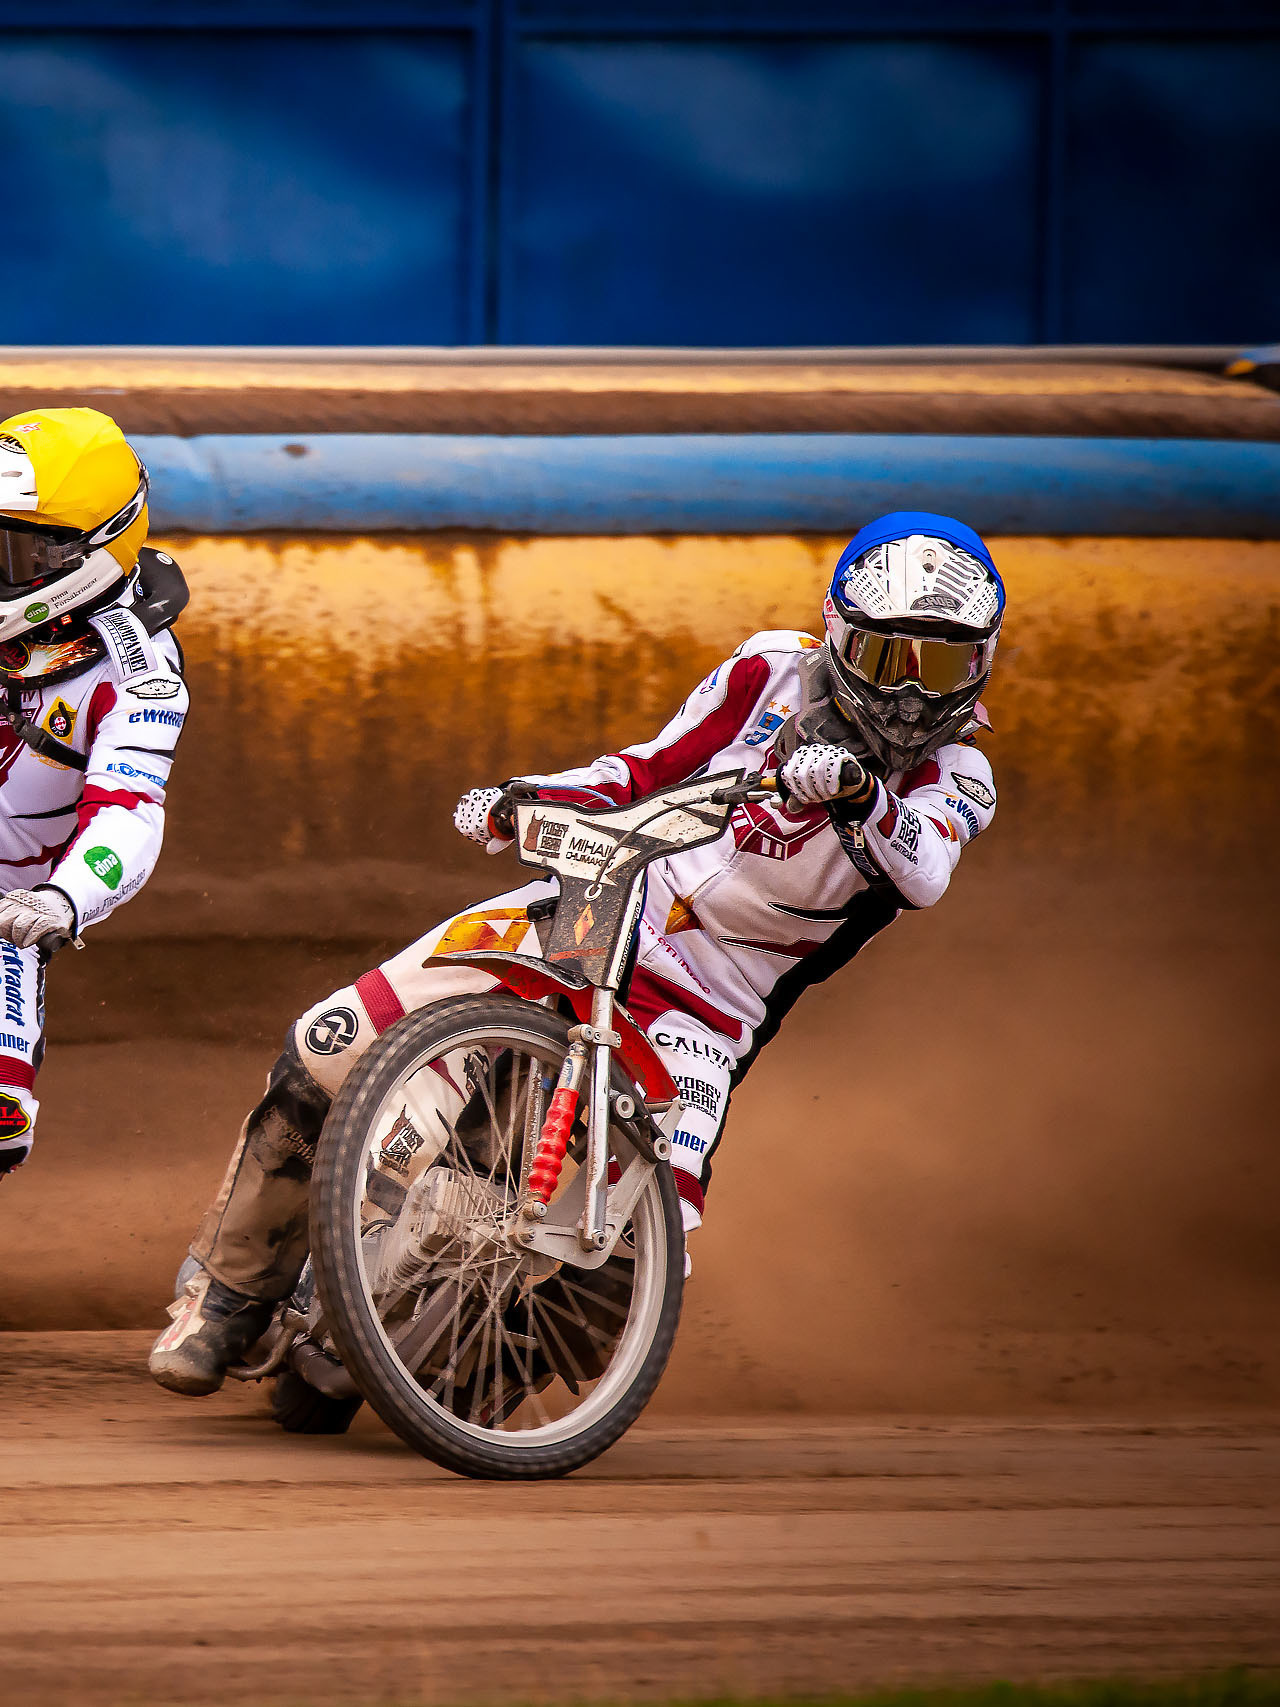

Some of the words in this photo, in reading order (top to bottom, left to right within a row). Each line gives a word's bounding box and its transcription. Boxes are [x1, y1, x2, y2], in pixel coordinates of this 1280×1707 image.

[26, 605, 48, 619] dina
[94, 853, 119, 876] dina
[671, 1075, 721, 1103] YOGGY
[679, 1088, 718, 1114] BEAR
